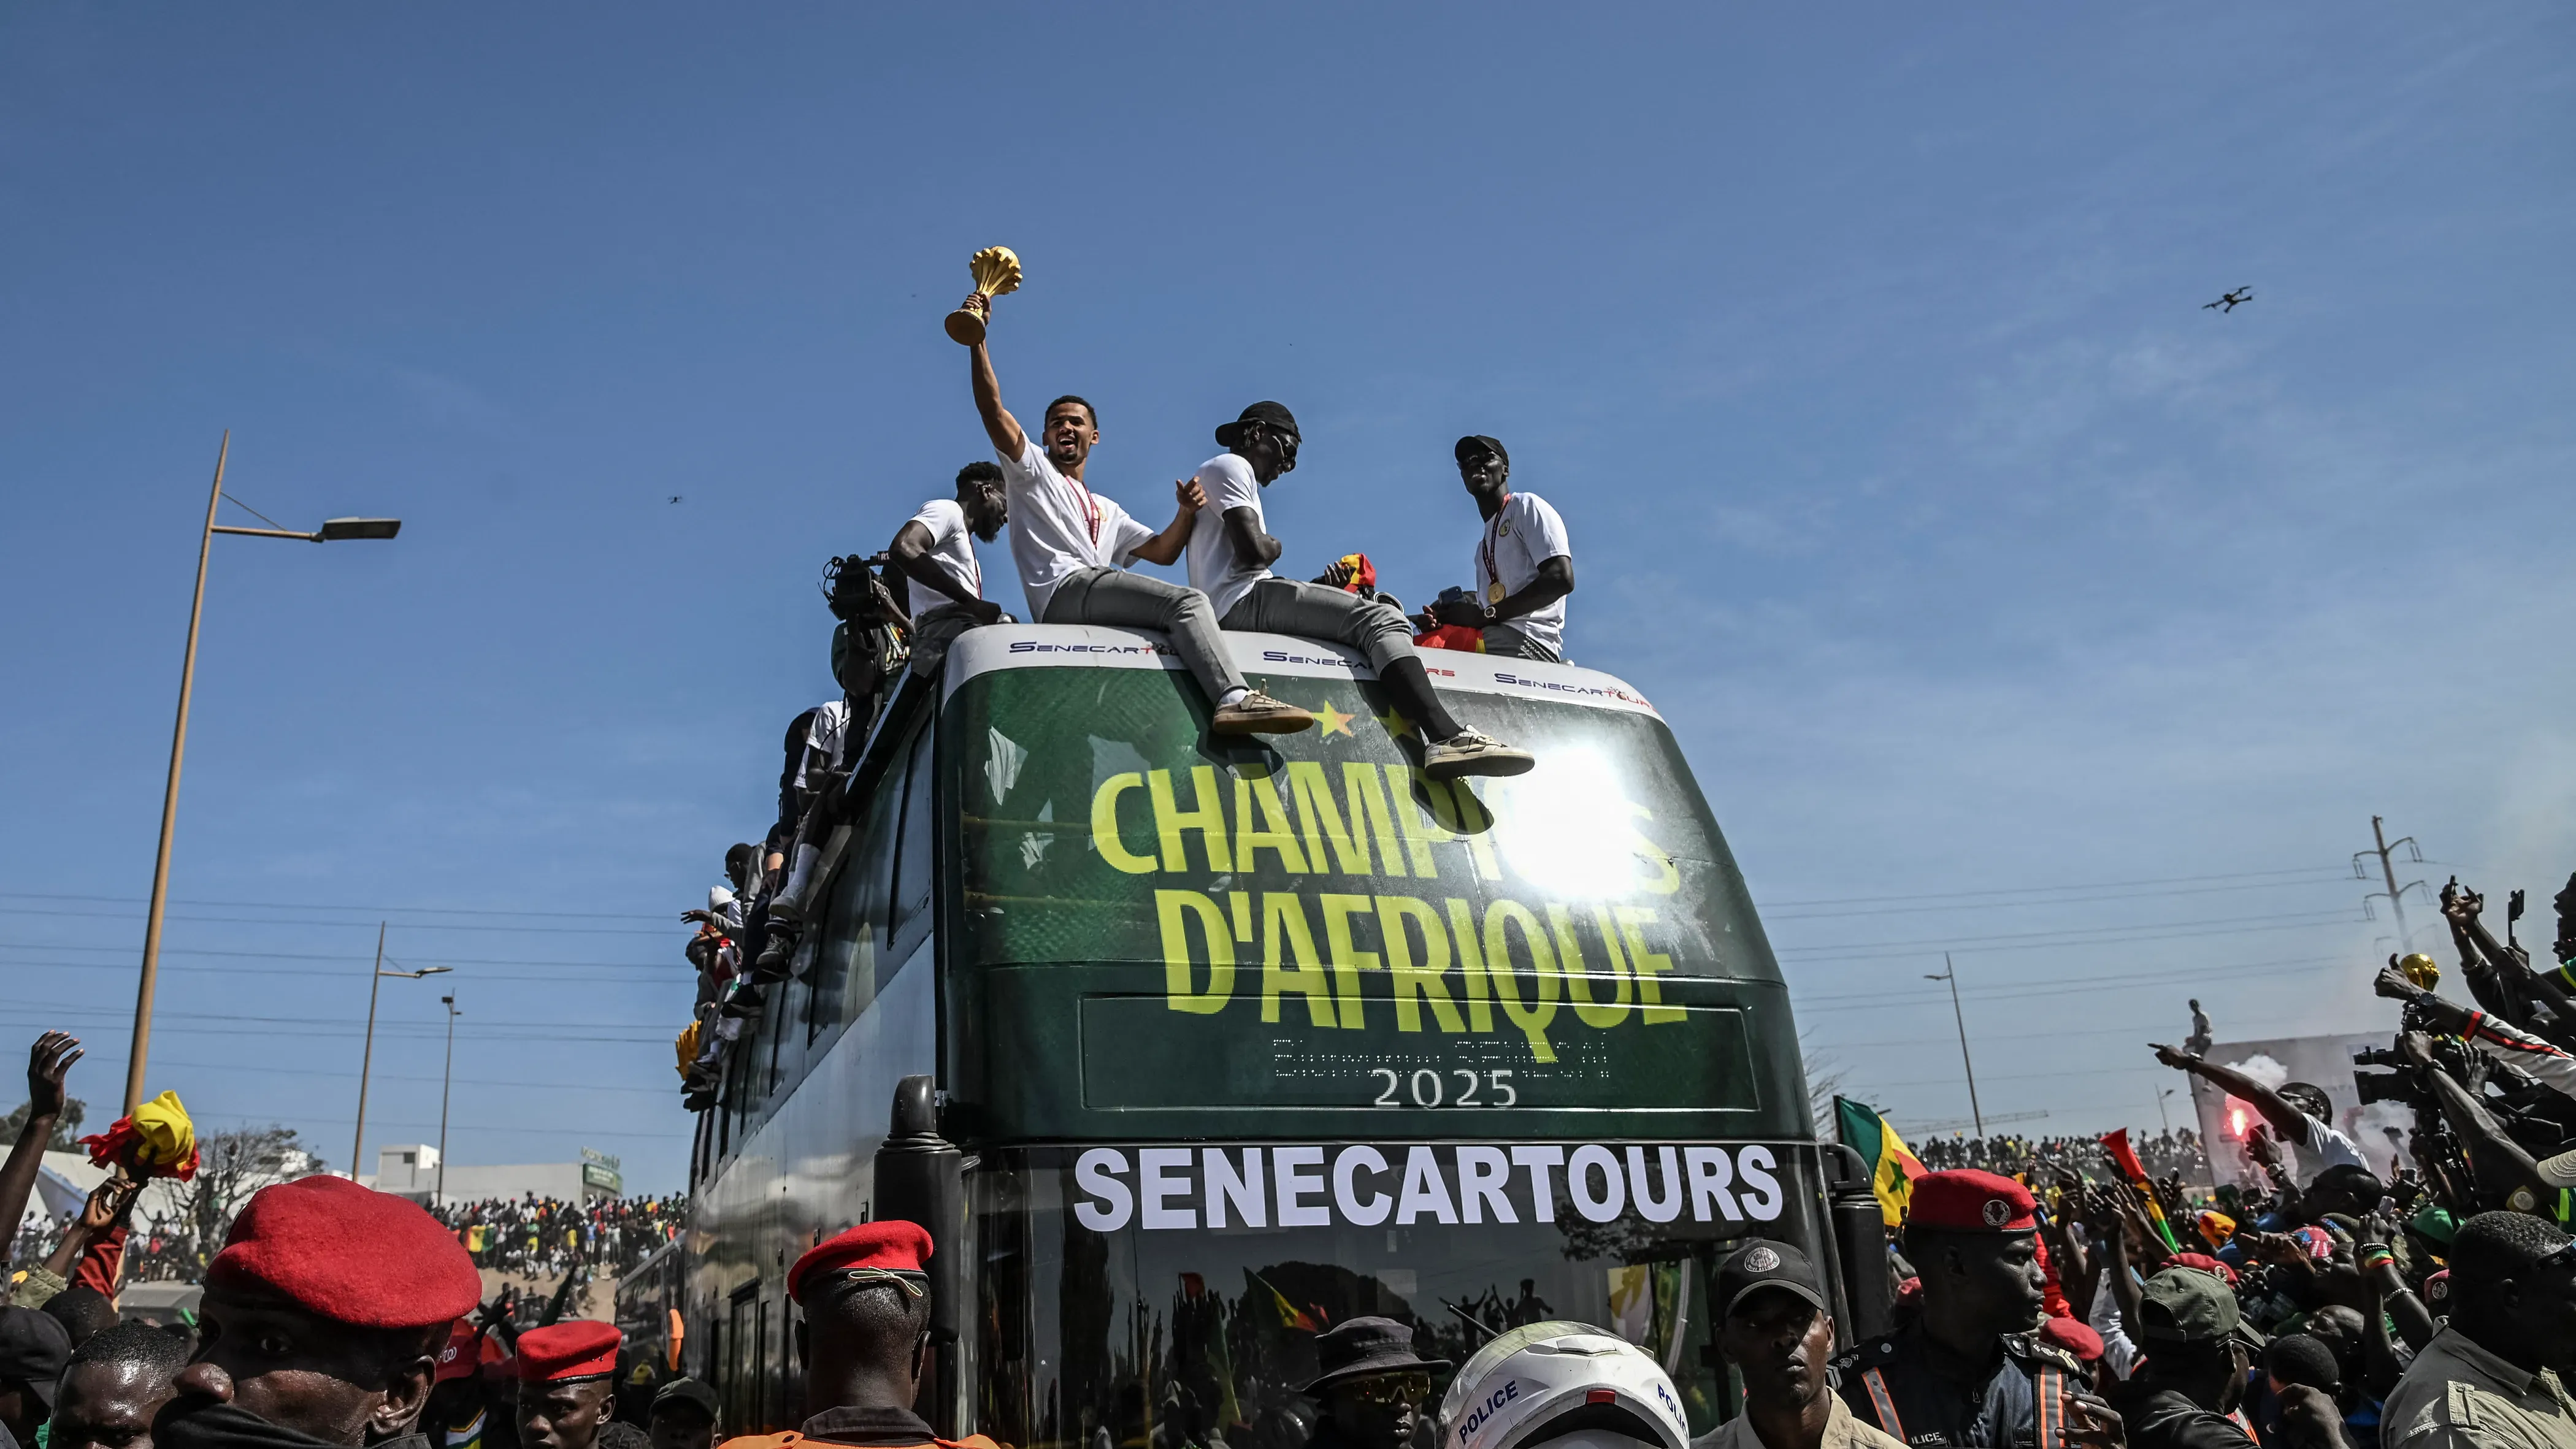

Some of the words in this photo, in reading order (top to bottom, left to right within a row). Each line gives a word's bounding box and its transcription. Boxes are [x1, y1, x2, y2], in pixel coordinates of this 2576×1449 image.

[1154, 889, 1689, 1063] D'AFRIQUE
[1373, 1068, 1517, 1107] 2025
[1074, 1144, 1783, 1232] SENECARTOURS
[1459, 1379, 1519, 1446] POLICE
